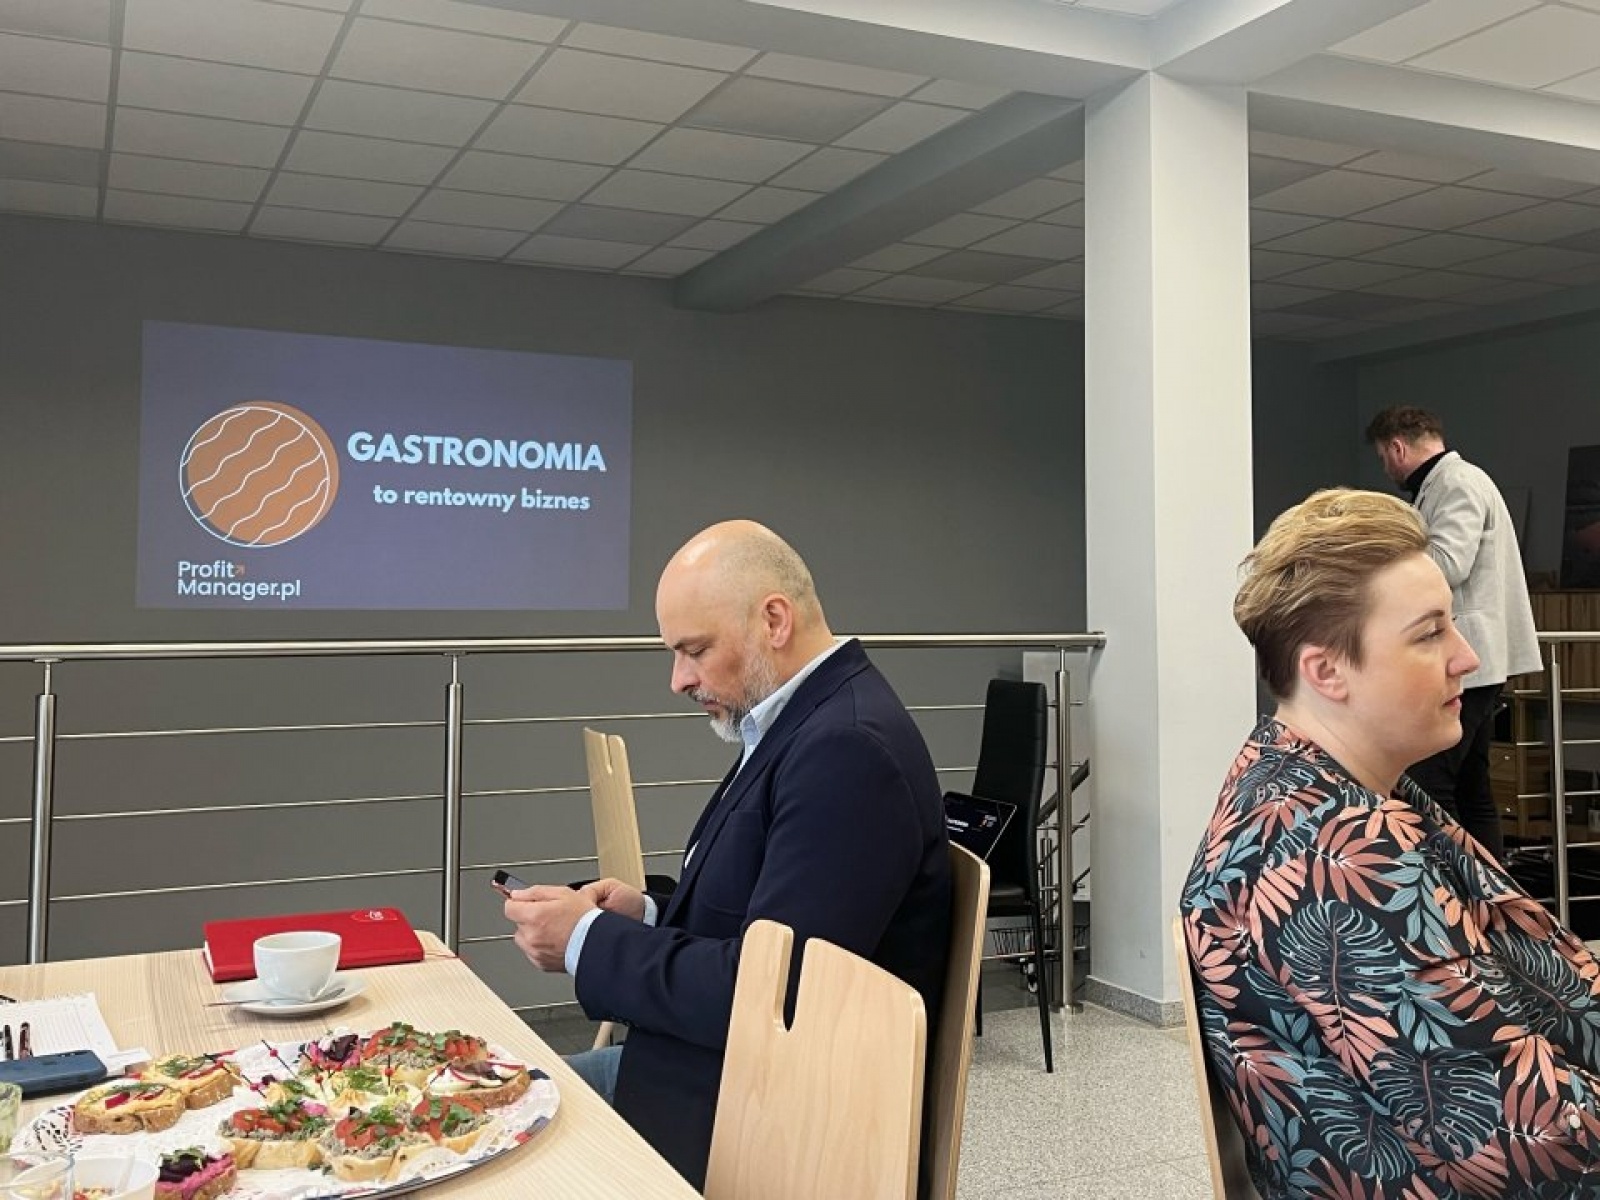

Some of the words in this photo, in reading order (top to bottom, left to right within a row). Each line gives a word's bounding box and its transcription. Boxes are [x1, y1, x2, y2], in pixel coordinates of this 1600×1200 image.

[347, 431, 607, 472] GASTRONOMIA
[373, 484, 398, 504] to
[404, 487, 515, 513] rentowny
[521, 487, 590, 510] biznes
[177, 560, 235, 578] Profit
[177, 579, 301, 601] Manager.pl
